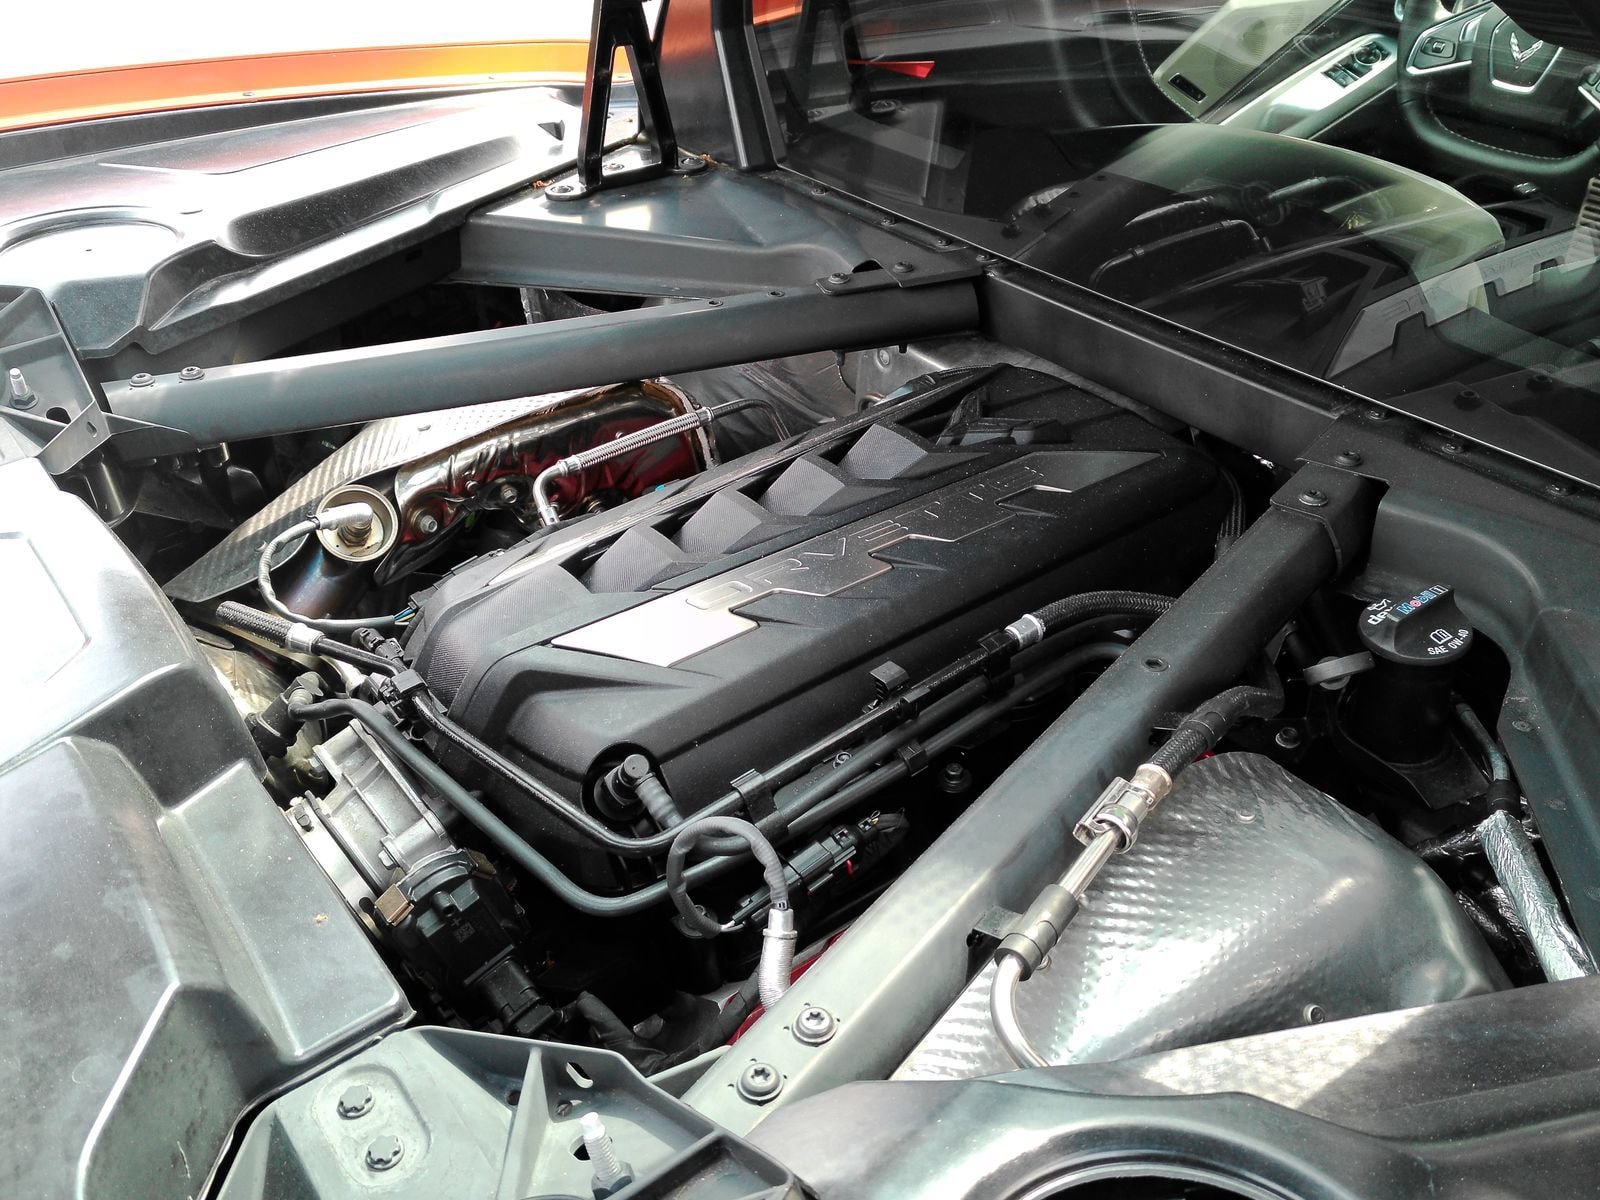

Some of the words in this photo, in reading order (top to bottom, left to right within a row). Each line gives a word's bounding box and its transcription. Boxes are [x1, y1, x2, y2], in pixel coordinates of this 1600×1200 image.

[1396, 590, 1437, 614] Mobil
[1427, 646, 1449, 655] SAE
[1448, 629, 1469, 649] 0W-40
